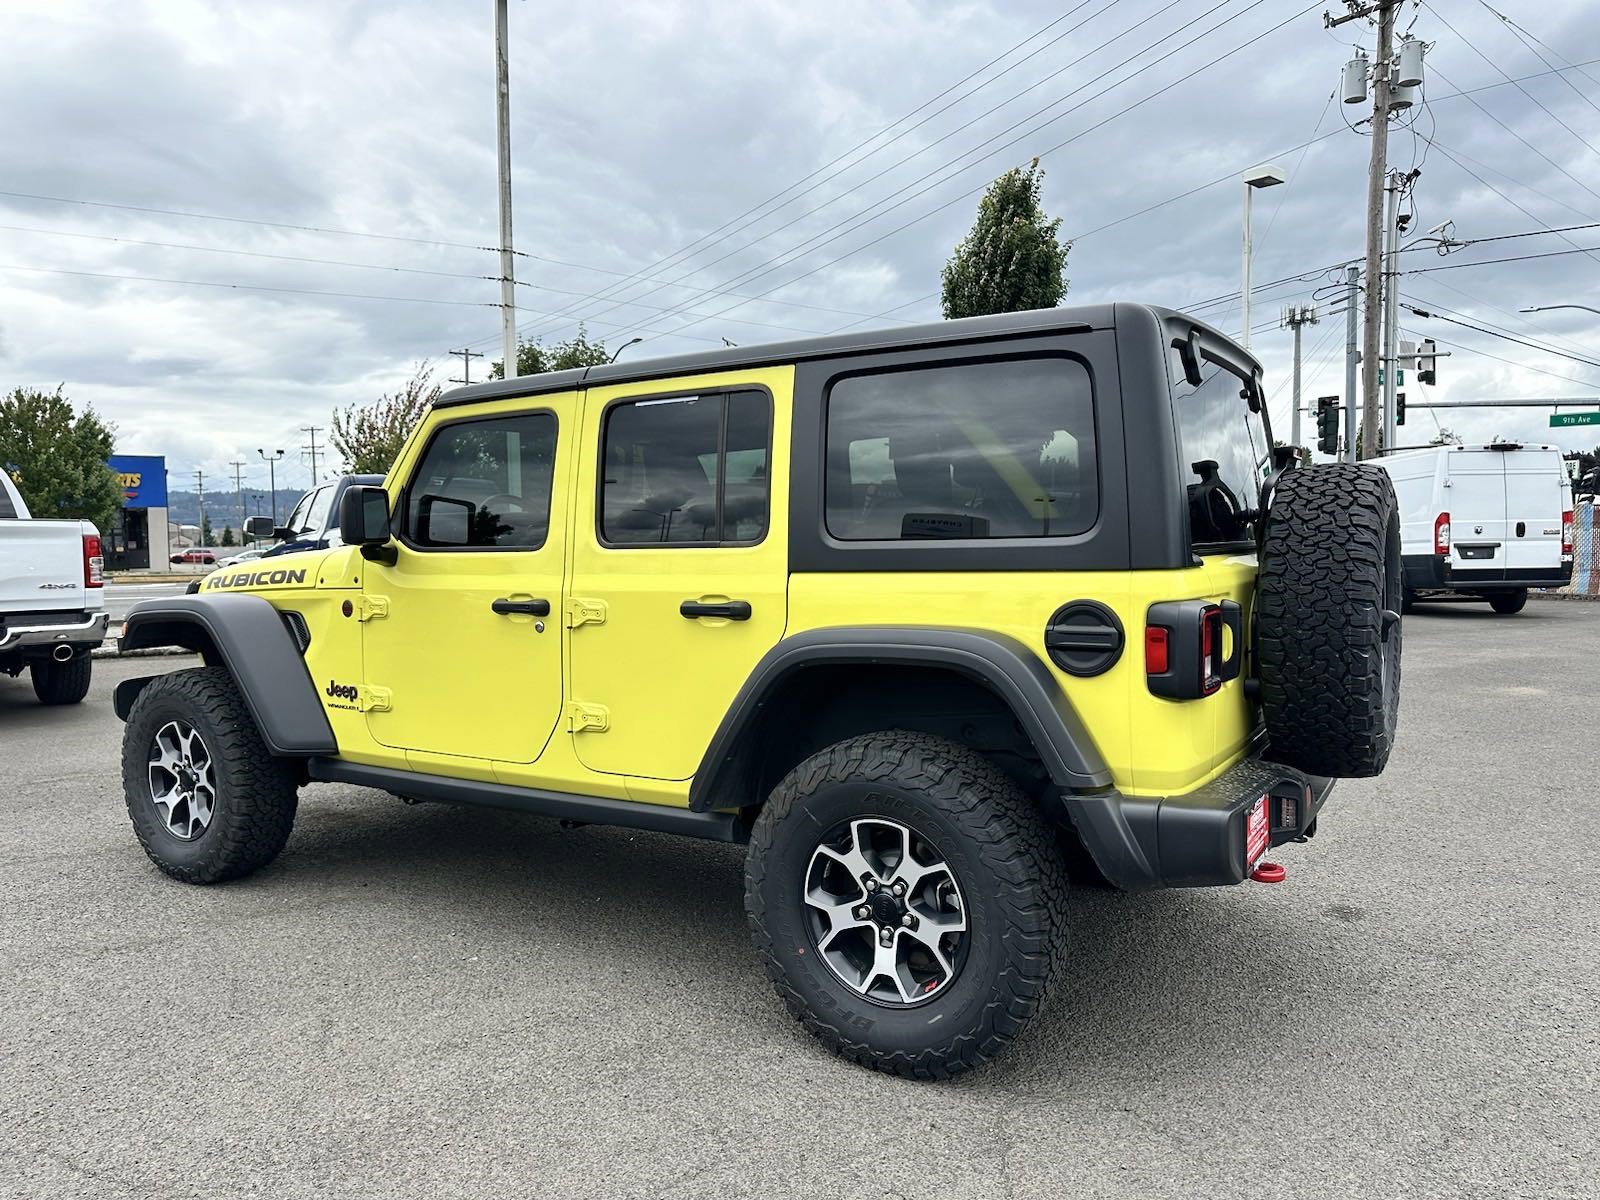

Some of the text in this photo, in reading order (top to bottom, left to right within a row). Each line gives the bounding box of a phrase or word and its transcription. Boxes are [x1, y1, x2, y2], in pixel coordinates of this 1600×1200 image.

[1577, 415, 1591, 423] Ave
[206, 569, 307, 589] RUBICON
[326, 679, 358, 702] Jeep
